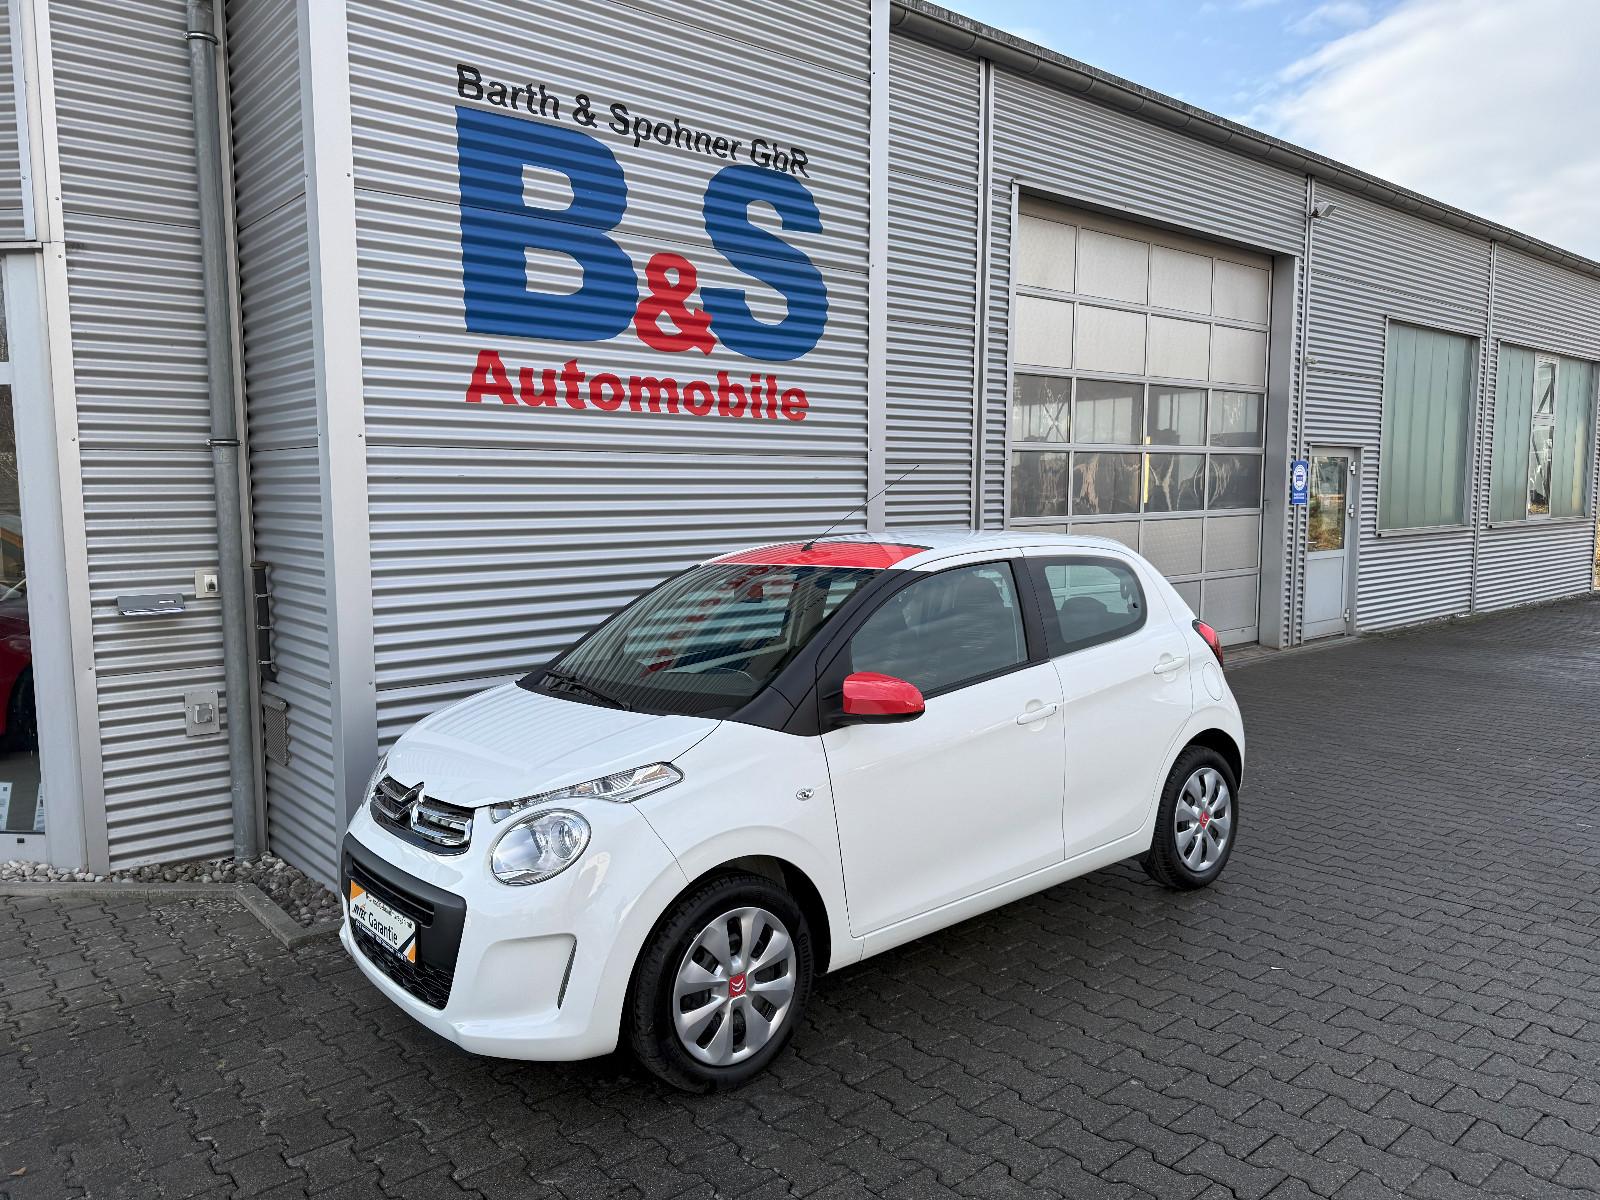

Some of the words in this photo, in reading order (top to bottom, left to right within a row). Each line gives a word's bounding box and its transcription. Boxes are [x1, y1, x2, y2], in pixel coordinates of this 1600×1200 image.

[457, 64, 560, 119] Barth
[572, 94, 598, 128] &
[609, 103, 742, 160] Spohner
[750, 138, 810, 178] GbR
[465, 350, 809, 421] Automobile
[368, 912, 398, 945] Garantie
